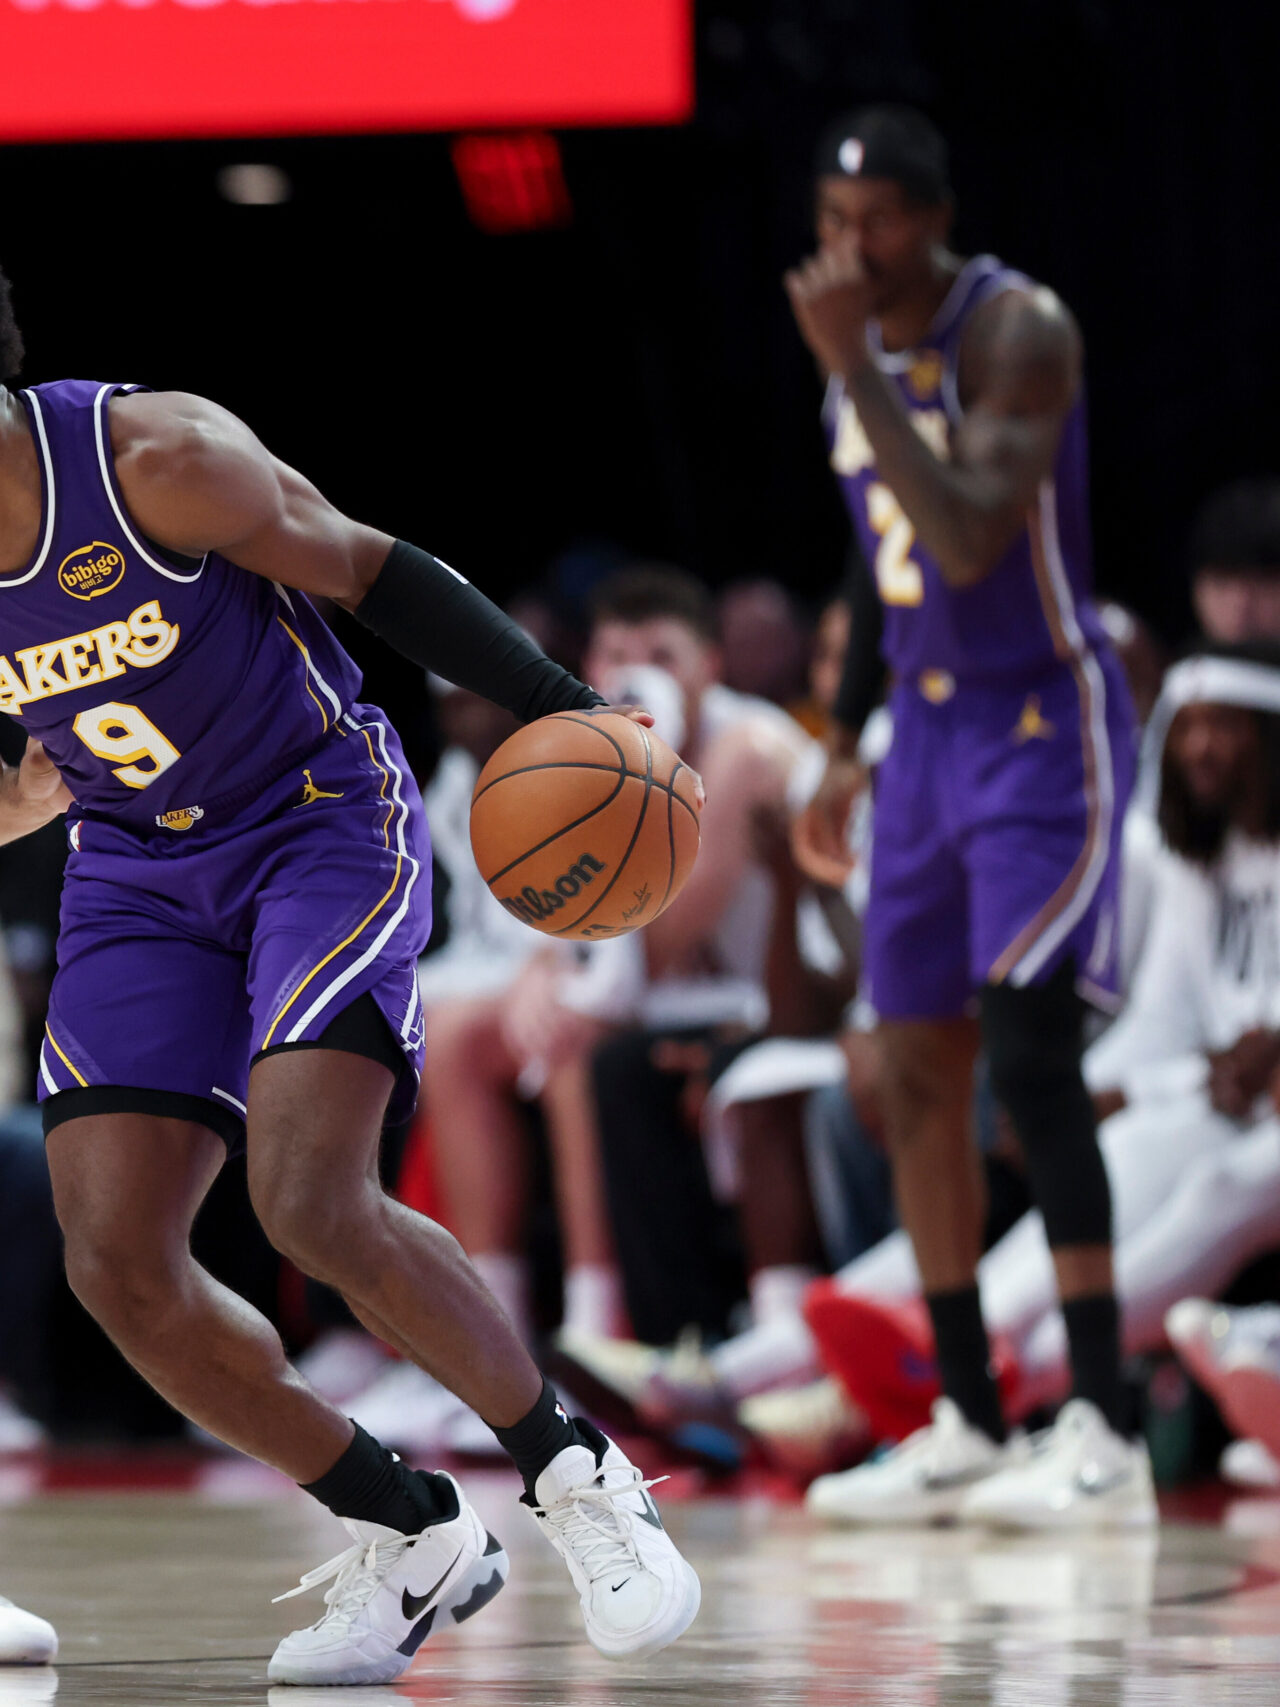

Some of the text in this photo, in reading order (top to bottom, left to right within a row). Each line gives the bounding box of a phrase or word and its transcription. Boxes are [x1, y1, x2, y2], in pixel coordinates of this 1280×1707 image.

[63, 554, 119, 587] bibigo
[72, 702, 182, 790] 9
[156, 805, 204, 826] LAKERS
